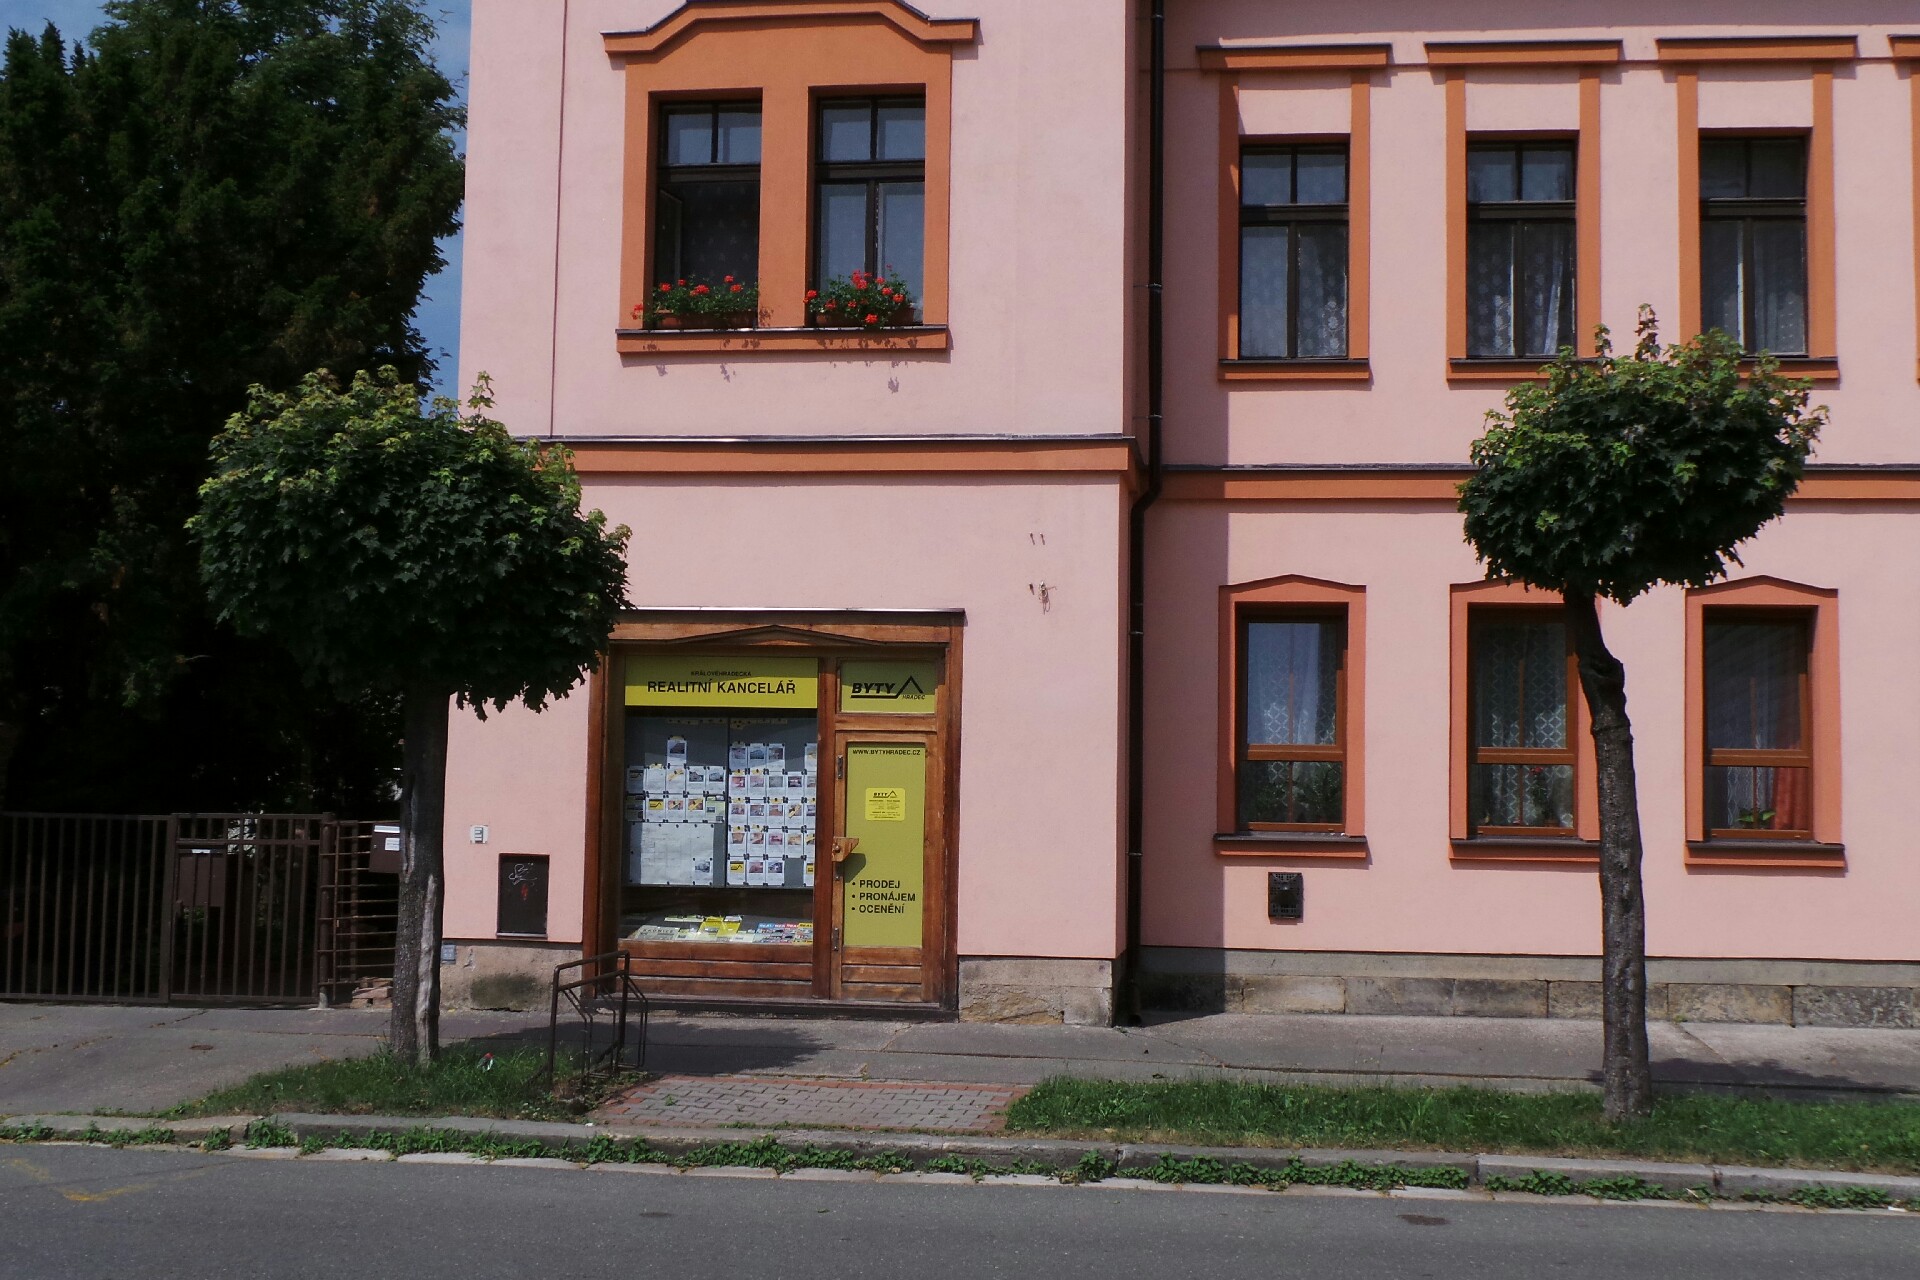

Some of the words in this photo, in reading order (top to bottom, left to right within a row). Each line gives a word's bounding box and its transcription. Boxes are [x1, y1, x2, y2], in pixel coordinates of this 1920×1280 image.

[647, 679, 712, 693] REALITNÍ
[717, 680, 796, 694] KANCELÁŘ
[852, 682, 895, 694] BYTY
[859, 879, 900, 889] PRODEJ
[859, 891, 916, 902] PRONÁJEM
[858, 903, 905, 914] OCENĚNÍ
